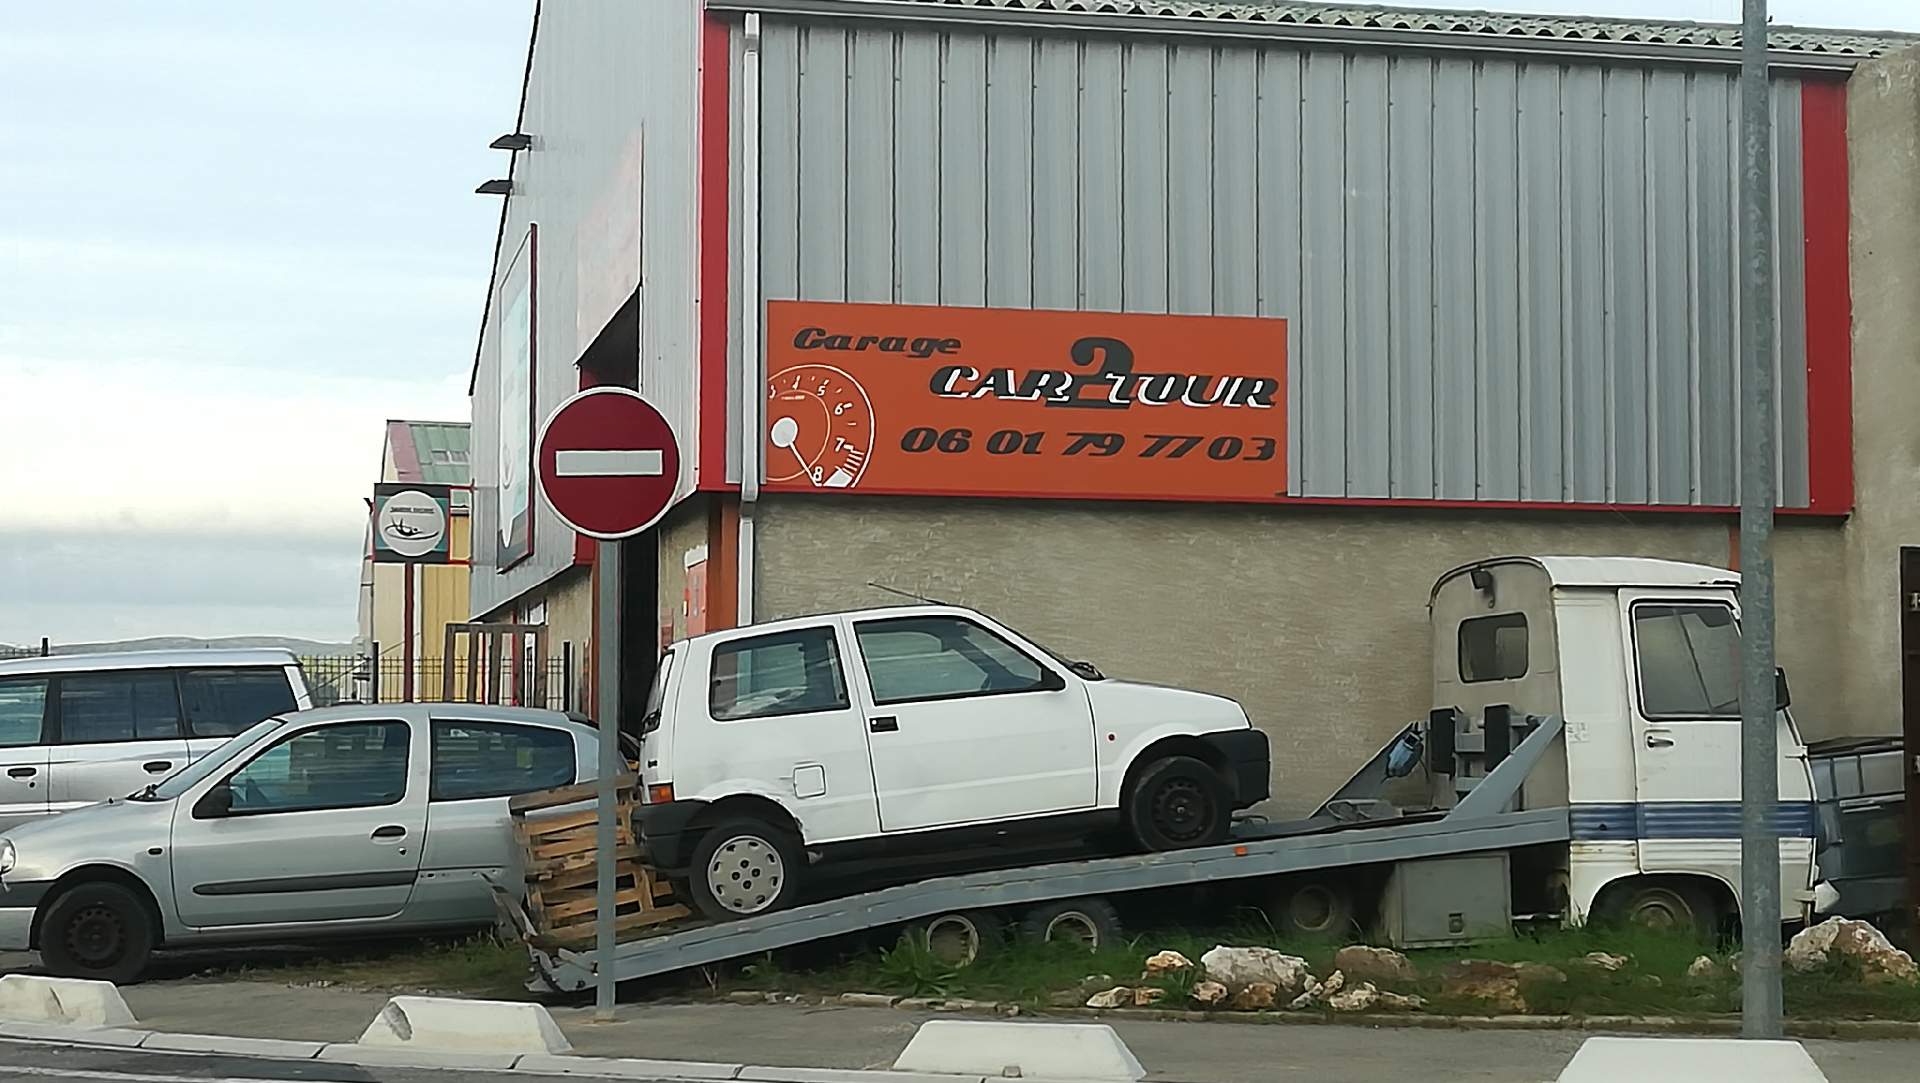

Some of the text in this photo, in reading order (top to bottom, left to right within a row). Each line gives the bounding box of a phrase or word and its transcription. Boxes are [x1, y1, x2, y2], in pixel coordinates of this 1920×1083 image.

[793, 327, 962, 358] Garage
[929, 336, 1279, 409] CAR 2 TOUR
[817, 385, 826, 396] 5
[834, 402, 845, 415] 6
[835, 436, 846, 452] 7
[900, 426, 1277, 461] 06 01 79 77 03
[813, 465, 824, 482] 8
